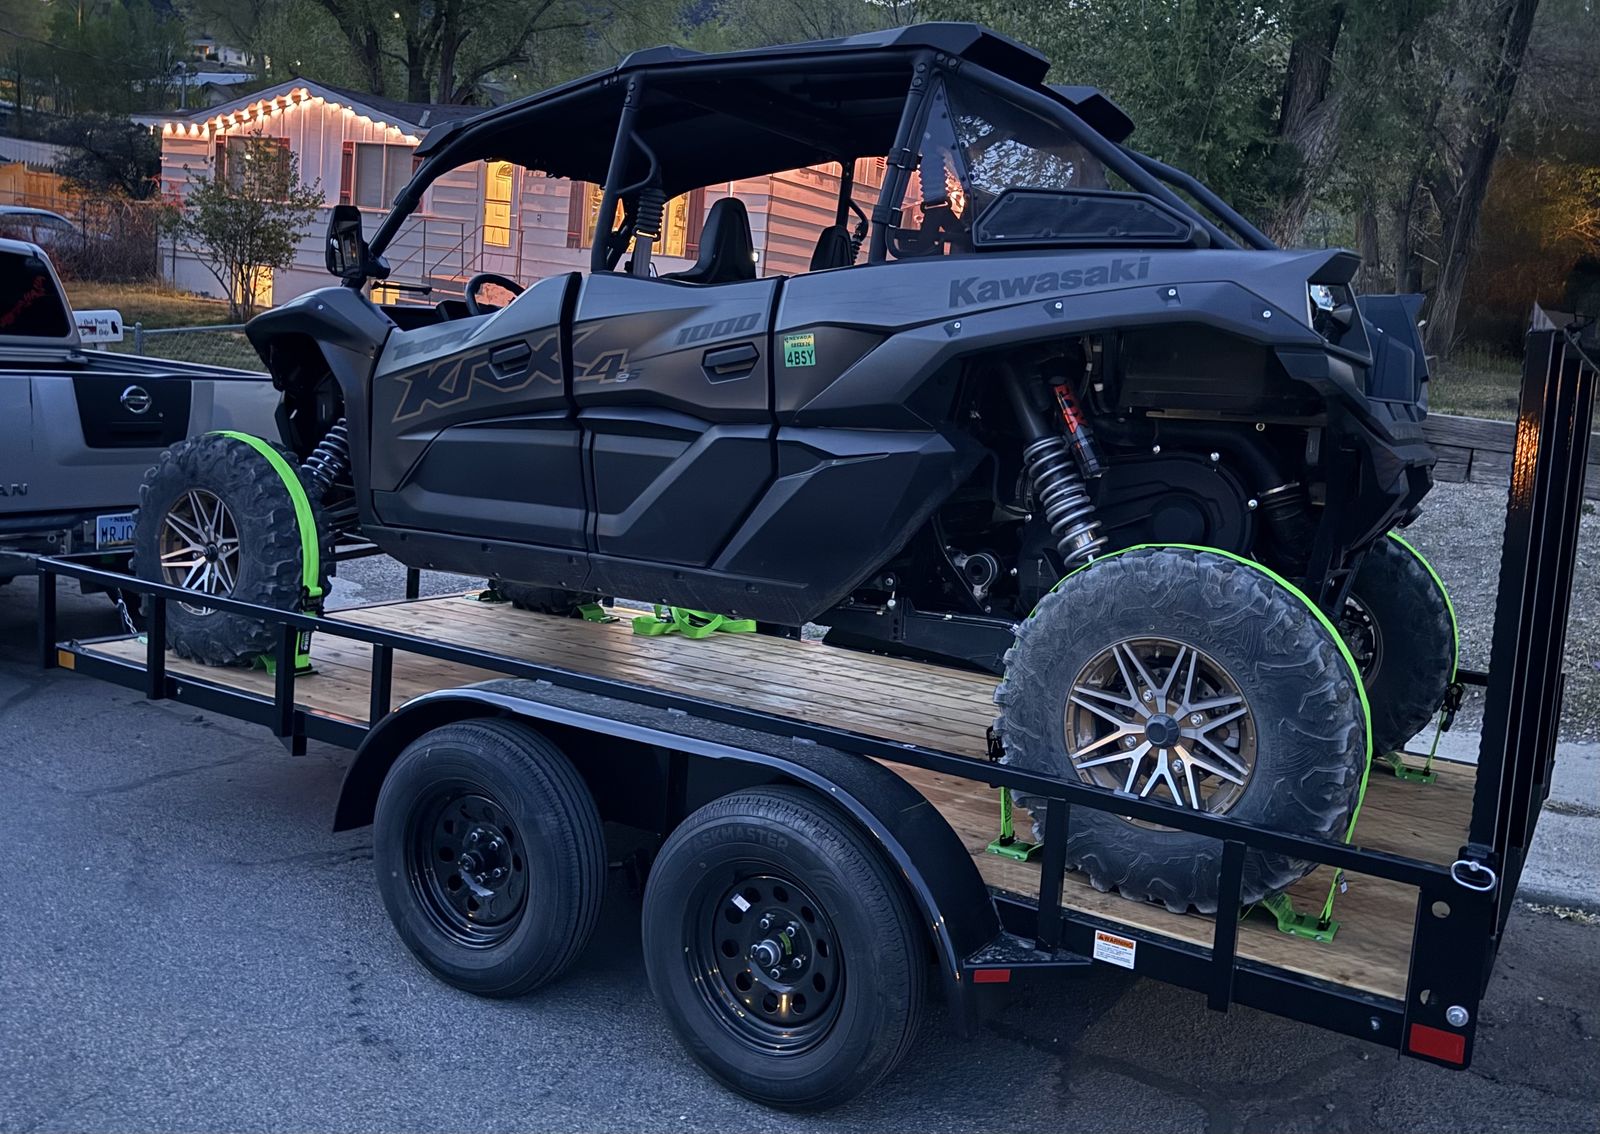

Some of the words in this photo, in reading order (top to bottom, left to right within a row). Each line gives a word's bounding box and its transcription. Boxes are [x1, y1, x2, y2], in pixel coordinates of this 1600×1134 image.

[949, 256, 1151, 309] Kawasaki
[675, 312, 762, 346] 1000
[787, 350, 814, 365] 4BSY
